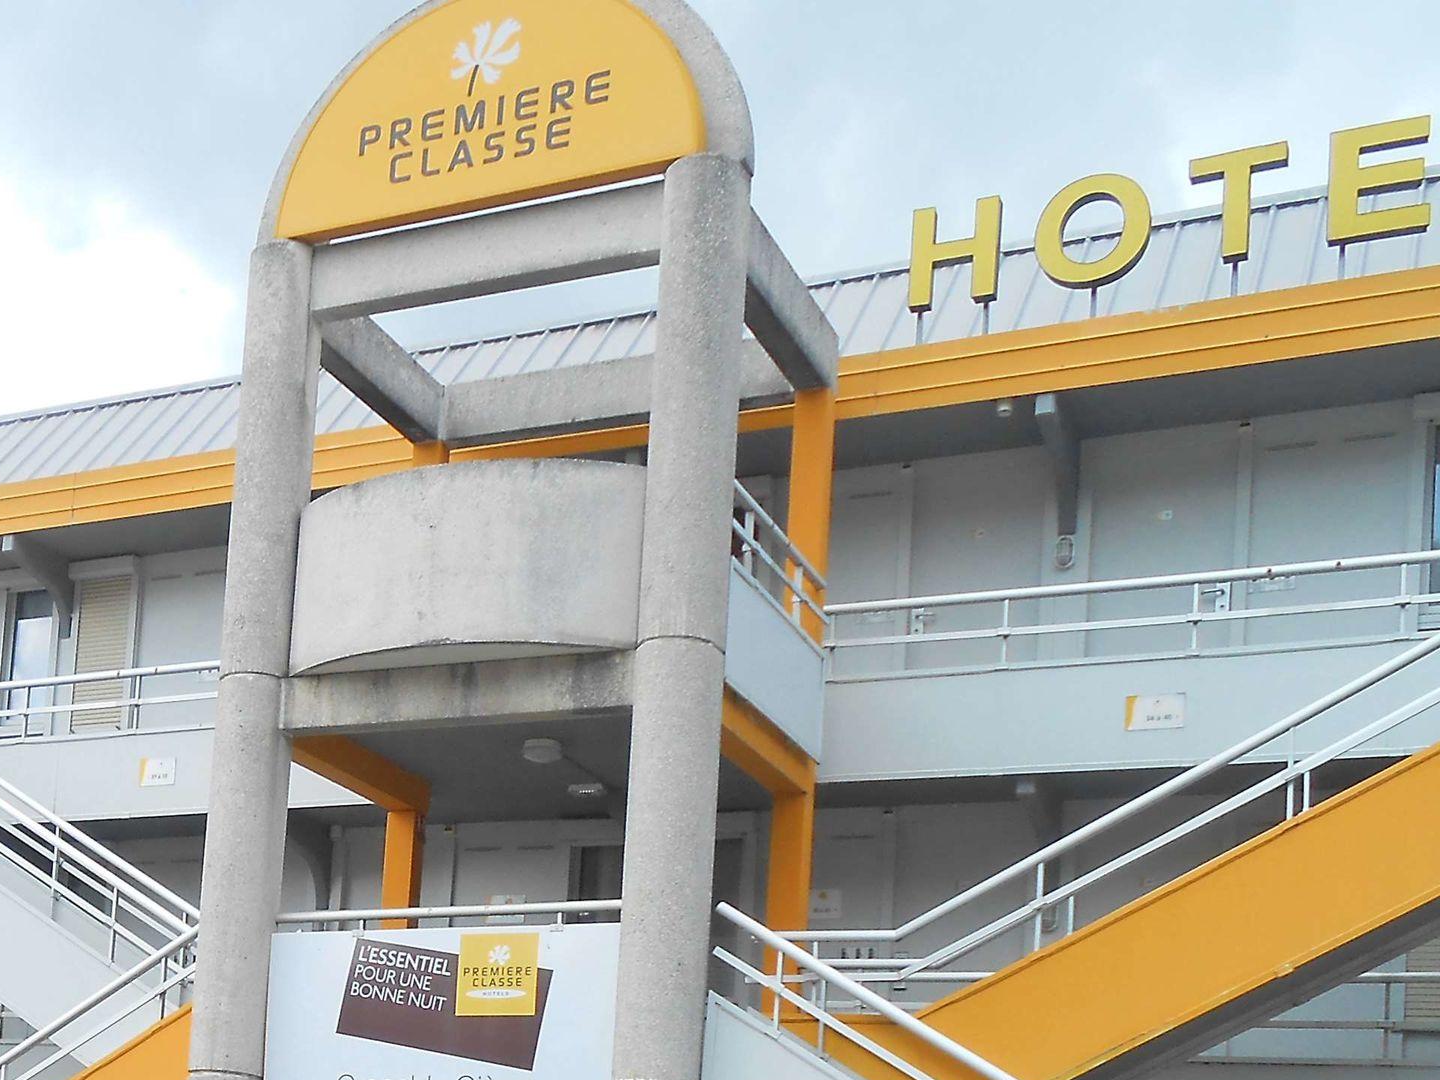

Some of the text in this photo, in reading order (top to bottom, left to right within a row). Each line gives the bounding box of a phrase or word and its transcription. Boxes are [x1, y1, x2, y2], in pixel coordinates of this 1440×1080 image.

[359, 70, 612, 156] PREMIERE
[389, 117, 572, 183] CLASSE
[908, 115, 1431, 312] HOTE
[358, 945, 451, 976] L'ESSENTIEL
[463, 966, 532, 977] PREMIERE
[354, 964, 432, 991] POUR UNE
[472, 977, 523, 987] CLASSE
[350, 981, 447, 1012] BONNE NUIT
